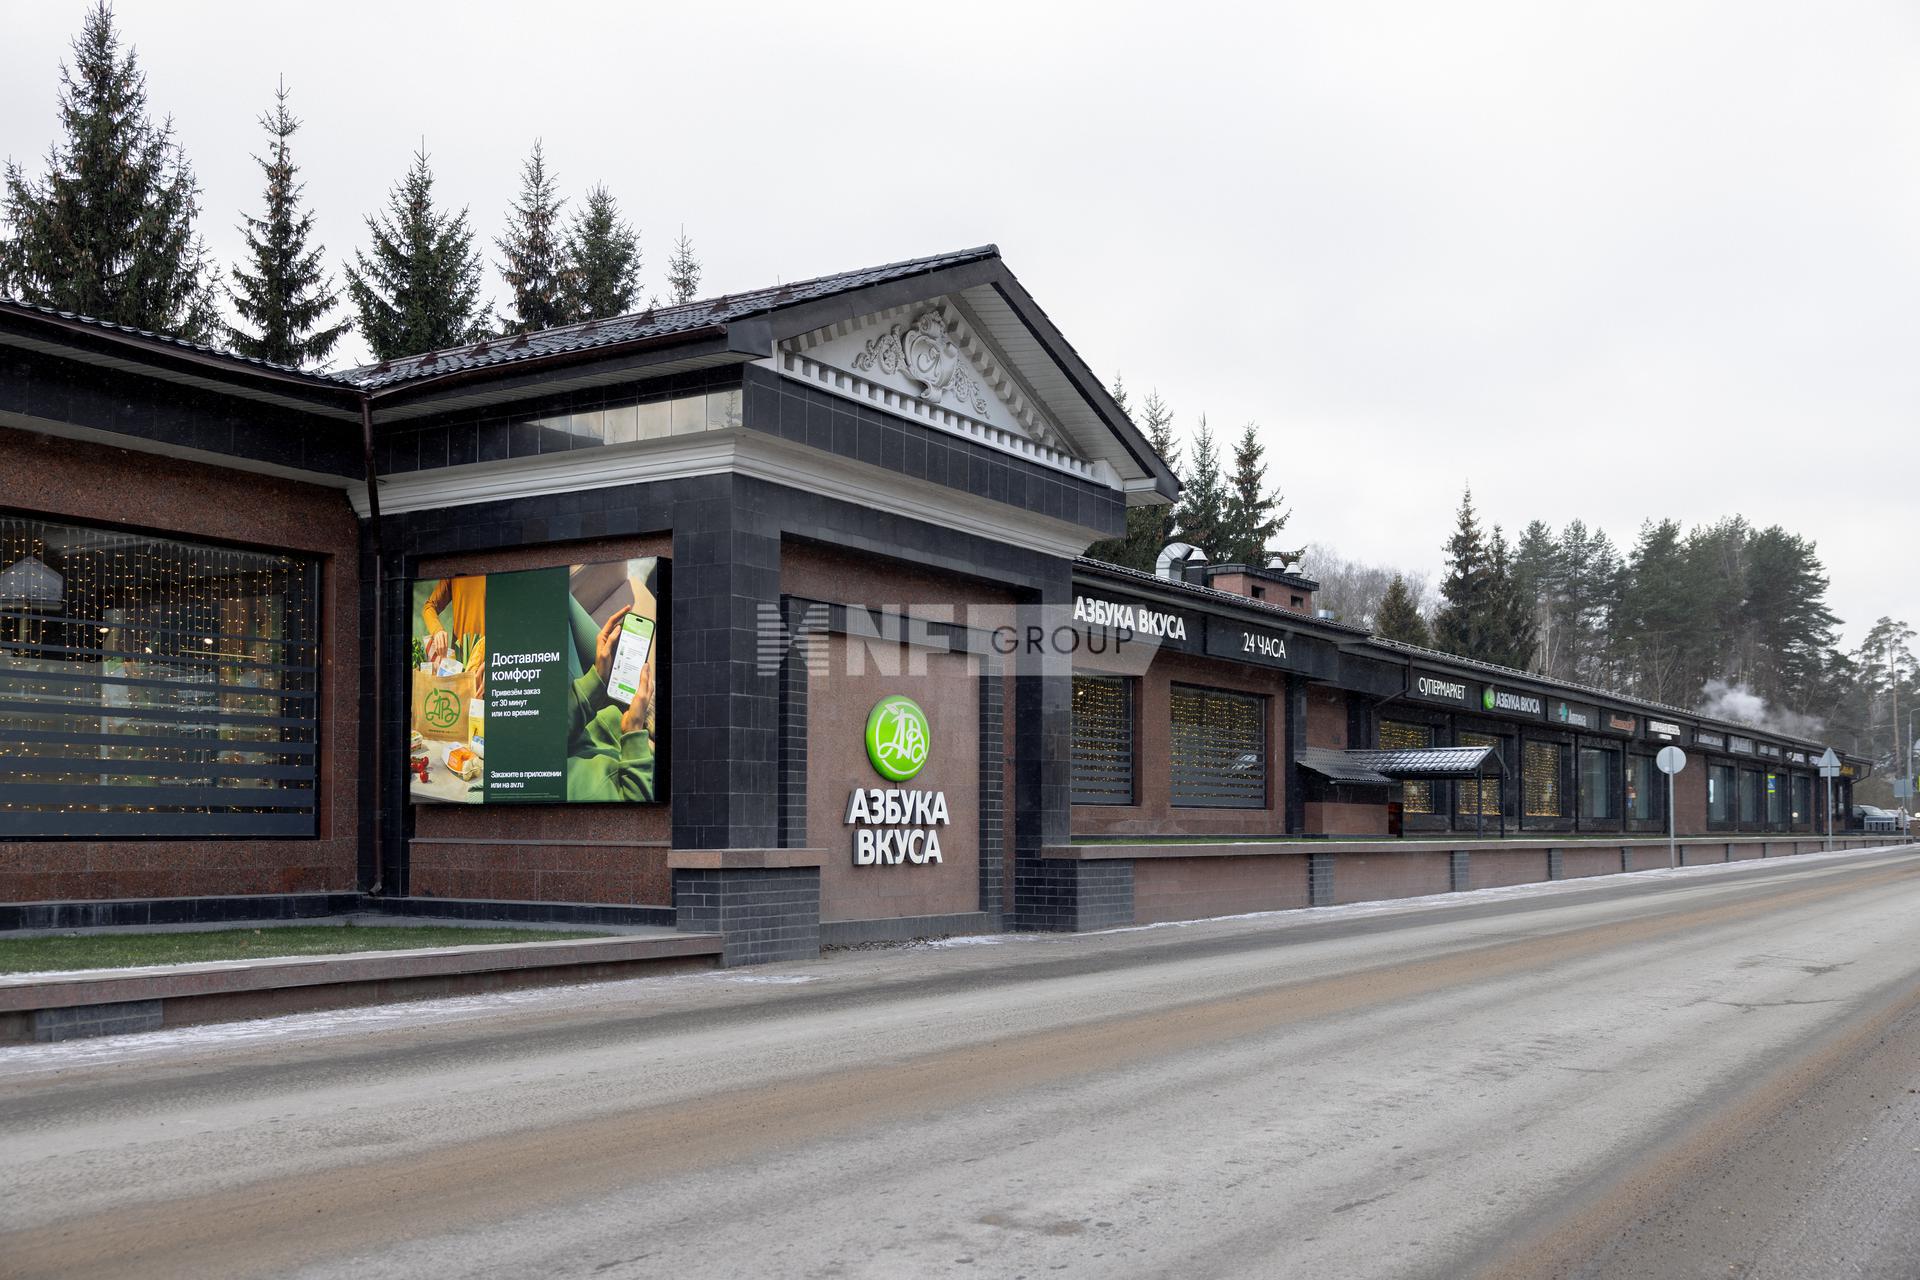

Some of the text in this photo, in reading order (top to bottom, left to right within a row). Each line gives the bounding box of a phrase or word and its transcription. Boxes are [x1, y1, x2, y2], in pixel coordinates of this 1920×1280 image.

[1073, 596, 1186, 641] АЗБУКА ВКУСА
[1243, 632, 1286, 659] 24 ЧАСА
[491, 652, 560, 667] Доставляем
[491, 667, 541, 683] комфорт
[491, 688, 522, 698] Привезём
[1418, 677, 1466, 700] СУПЕРМАРКЕТ
[508, 699, 528, 707] минут
[1496, 692, 1541, 714] АЗБУКА ВКУСА
[512, 709, 539, 717] времени
[524, 771, 562, 779] приложении
[845, 788, 950, 825] АЗБУКА
[853, 829, 943, 866] ВКУСА
